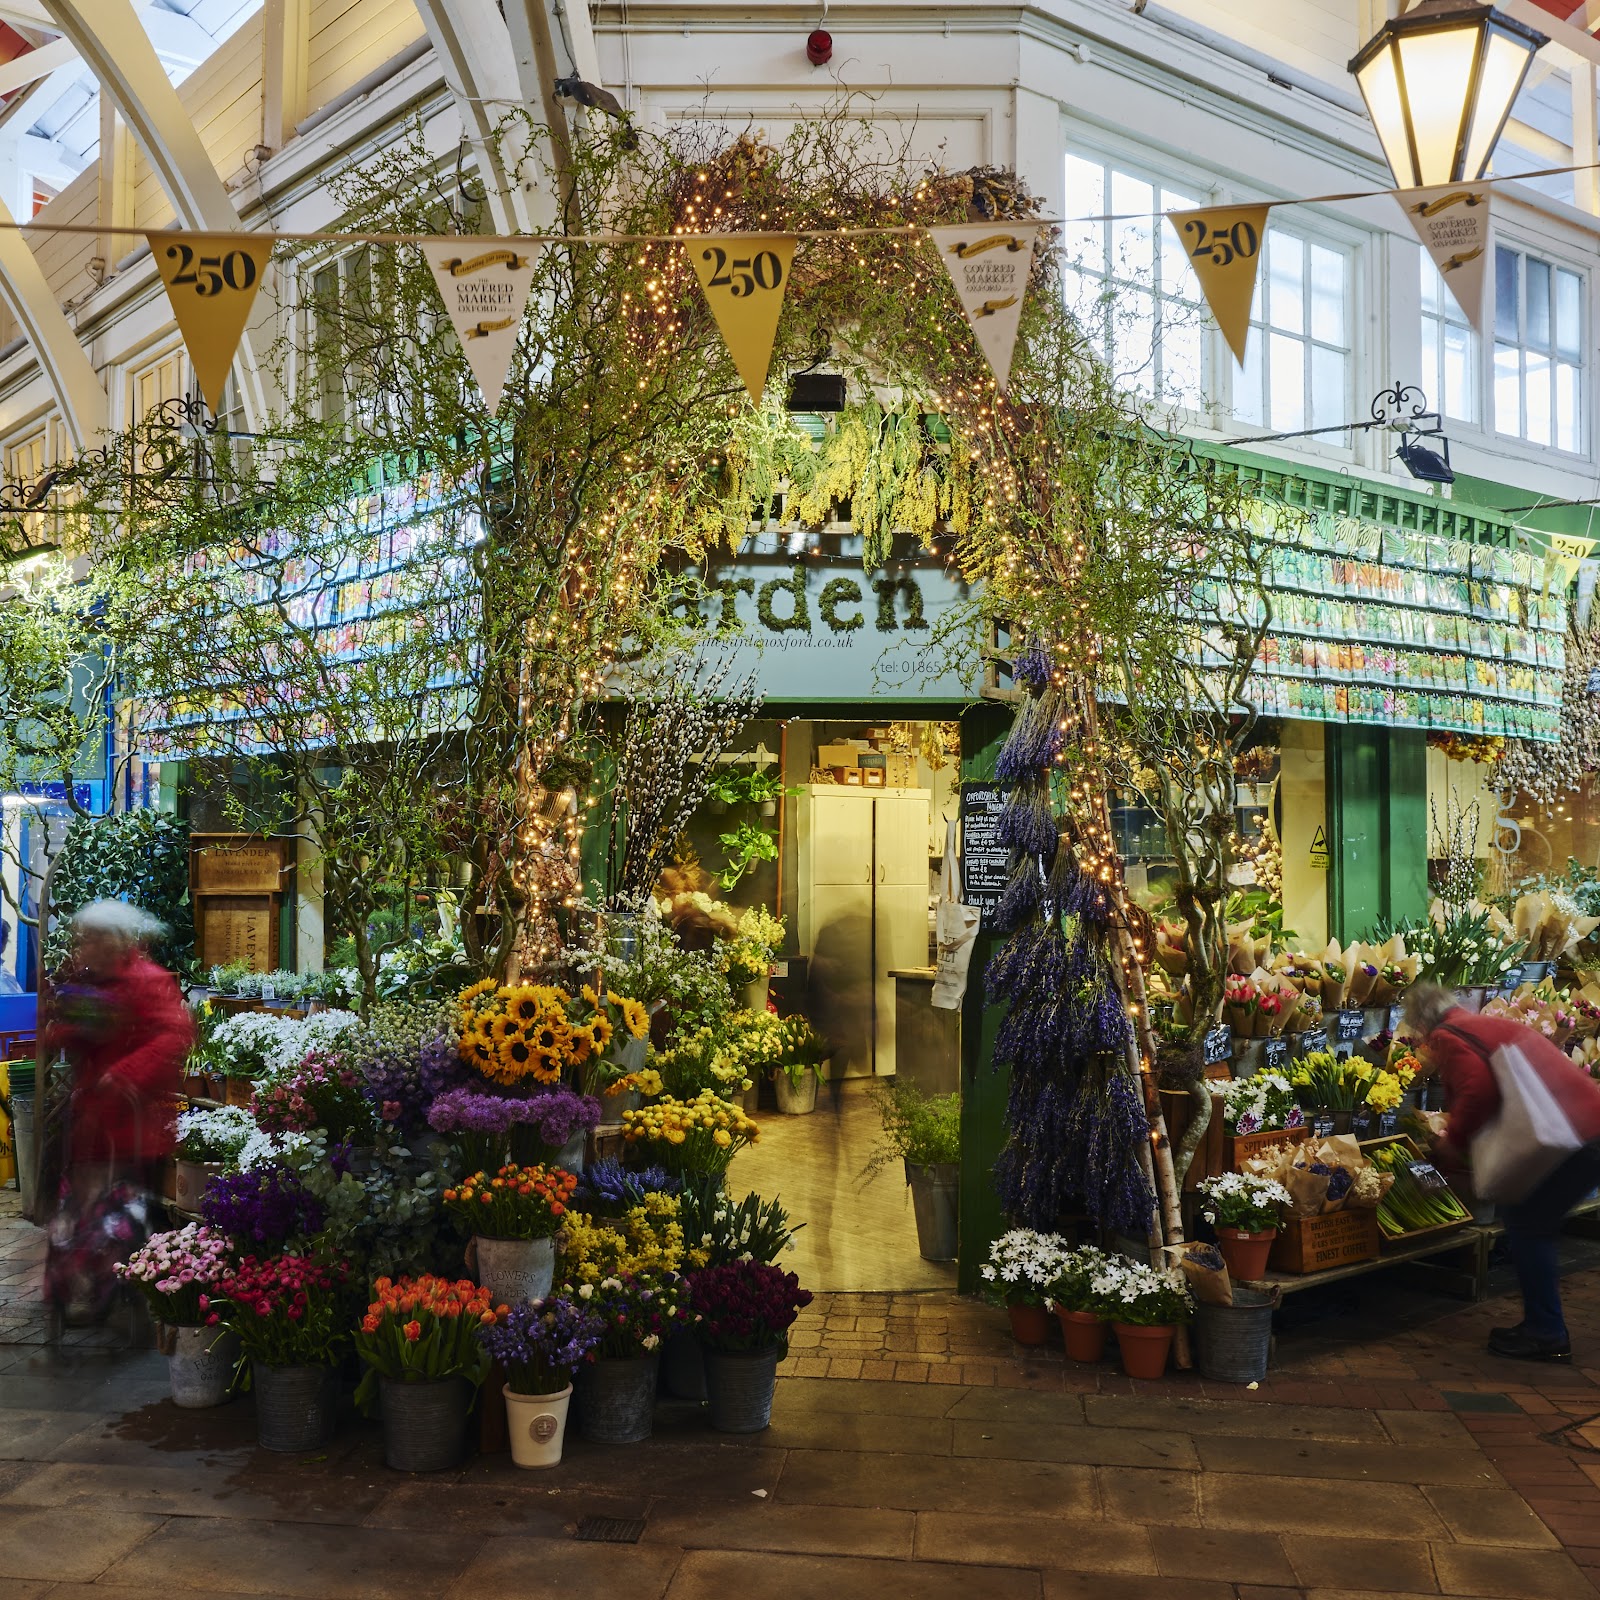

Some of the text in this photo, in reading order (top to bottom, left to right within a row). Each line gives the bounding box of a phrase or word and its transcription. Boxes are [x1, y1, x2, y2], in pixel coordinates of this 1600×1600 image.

[1428, 217, 1477, 231] COVERED
[1432, 226, 1478, 240] MARKET
[1185, 220, 1257, 265] 250
[167, 244, 256, 297] 250
[702, 247, 782, 297] 250
[964, 264, 1016, 274] COVERED
[965, 273, 1016, 284] MARKET
[456, 283, 514, 293] COVERED
[966, 284, 1002, 292] OXFORD
[458, 293, 514, 304] MARKET
[458, 304, 497, 313] OXFORD
[881, 660, 898, 674] tel:
[902, 660, 940, 674] 01865
[215, 848, 271, 858] LAVENDER
[246, 915, 256, 975] LAVEND
[1316, 1247, 1340, 1263] FINEST
[486, 1270, 536, 1284] FLOWERS
